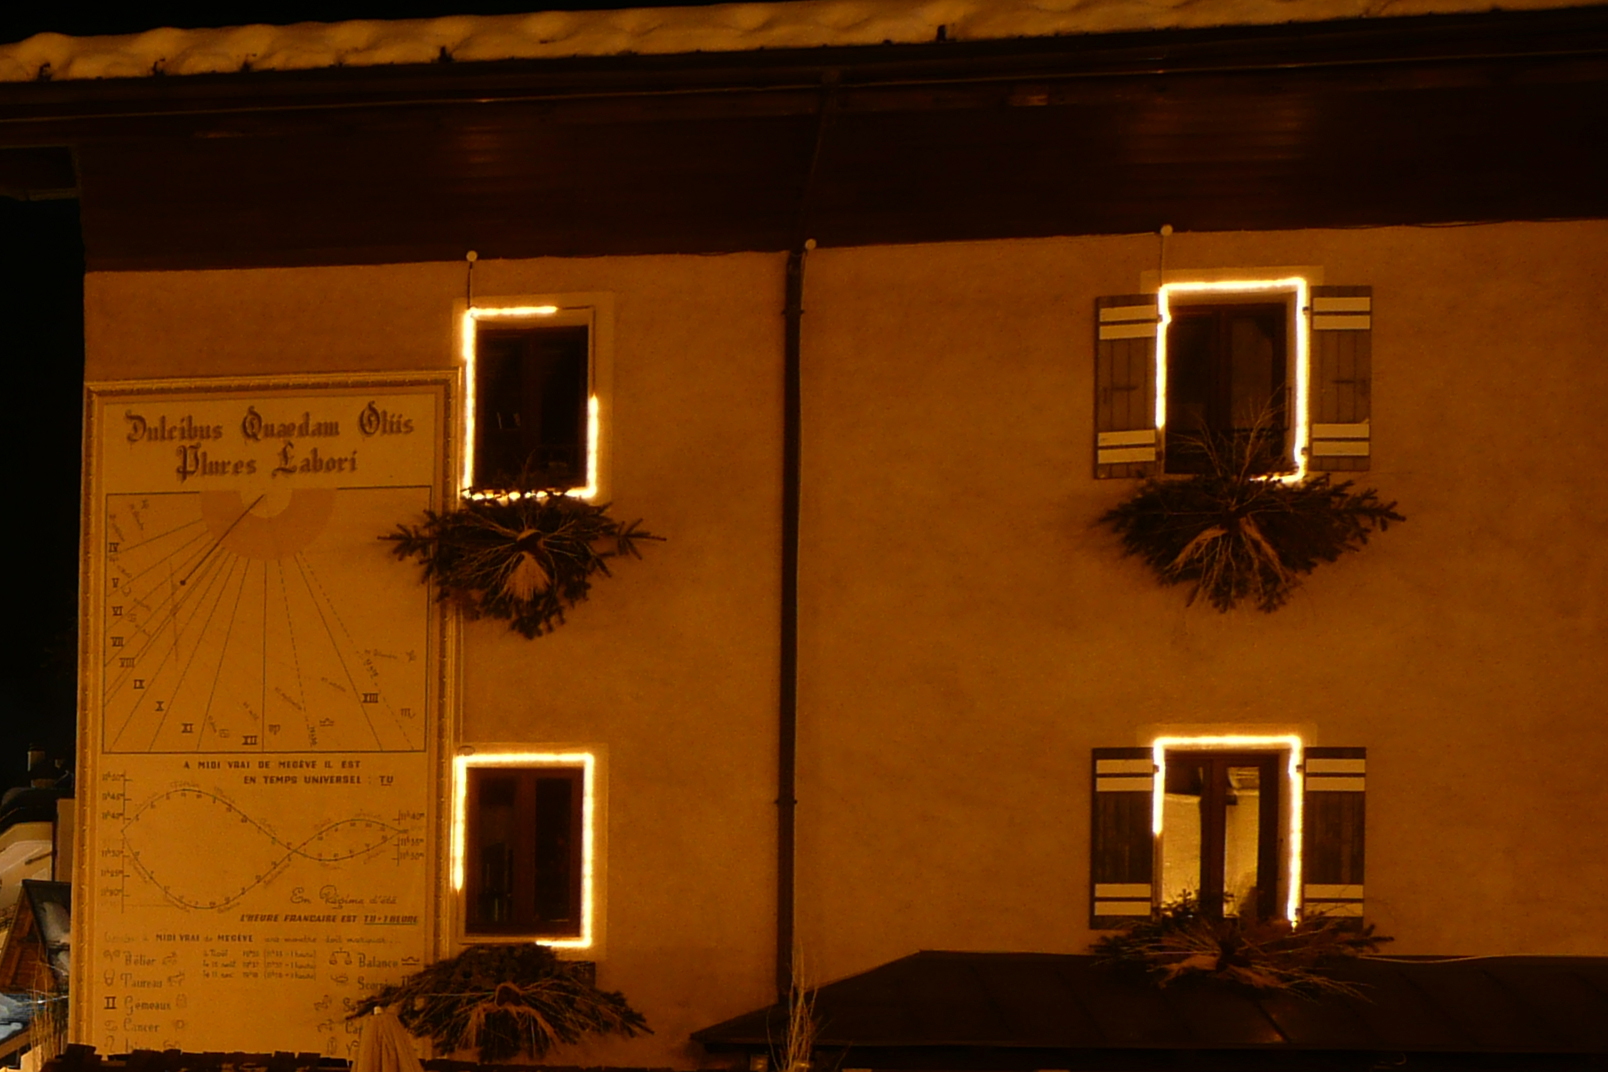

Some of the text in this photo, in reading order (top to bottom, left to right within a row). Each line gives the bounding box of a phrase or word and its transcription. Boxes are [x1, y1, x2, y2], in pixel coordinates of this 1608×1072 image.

[124, 408, 224, 444] Dulcibus
[176, 440, 358, 483] Plures Labori
[108, 542, 120, 553] IV
[111, 577, 120, 588] V
[112, 606, 123, 616] VI
[110, 636, 125, 647] VII
[119, 657, 136, 668] VIII
[133, 679, 145, 690] IX
[155, 701, 165, 712] X
[181, 723, 194, 734] XI
[241, 735, 259, 746] XII
[198, 760, 221, 769] MIDI
[227, 760, 250, 769] VRAI
[258, 760, 271, 769] DE
[324, 760, 334, 769] IL
[341, 760, 361, 769] EST
[244, 775, 256, 785] EN
[263, 775, 297, 785] TEMPS
[304, 775, 361, 785] UNIVERSEL
[379, 775, 394, 785] TU
[341, 914, 357, 923] EST
[156, 934, 176, 942] MIDI
[179, 934, 200, 942] VRAI
